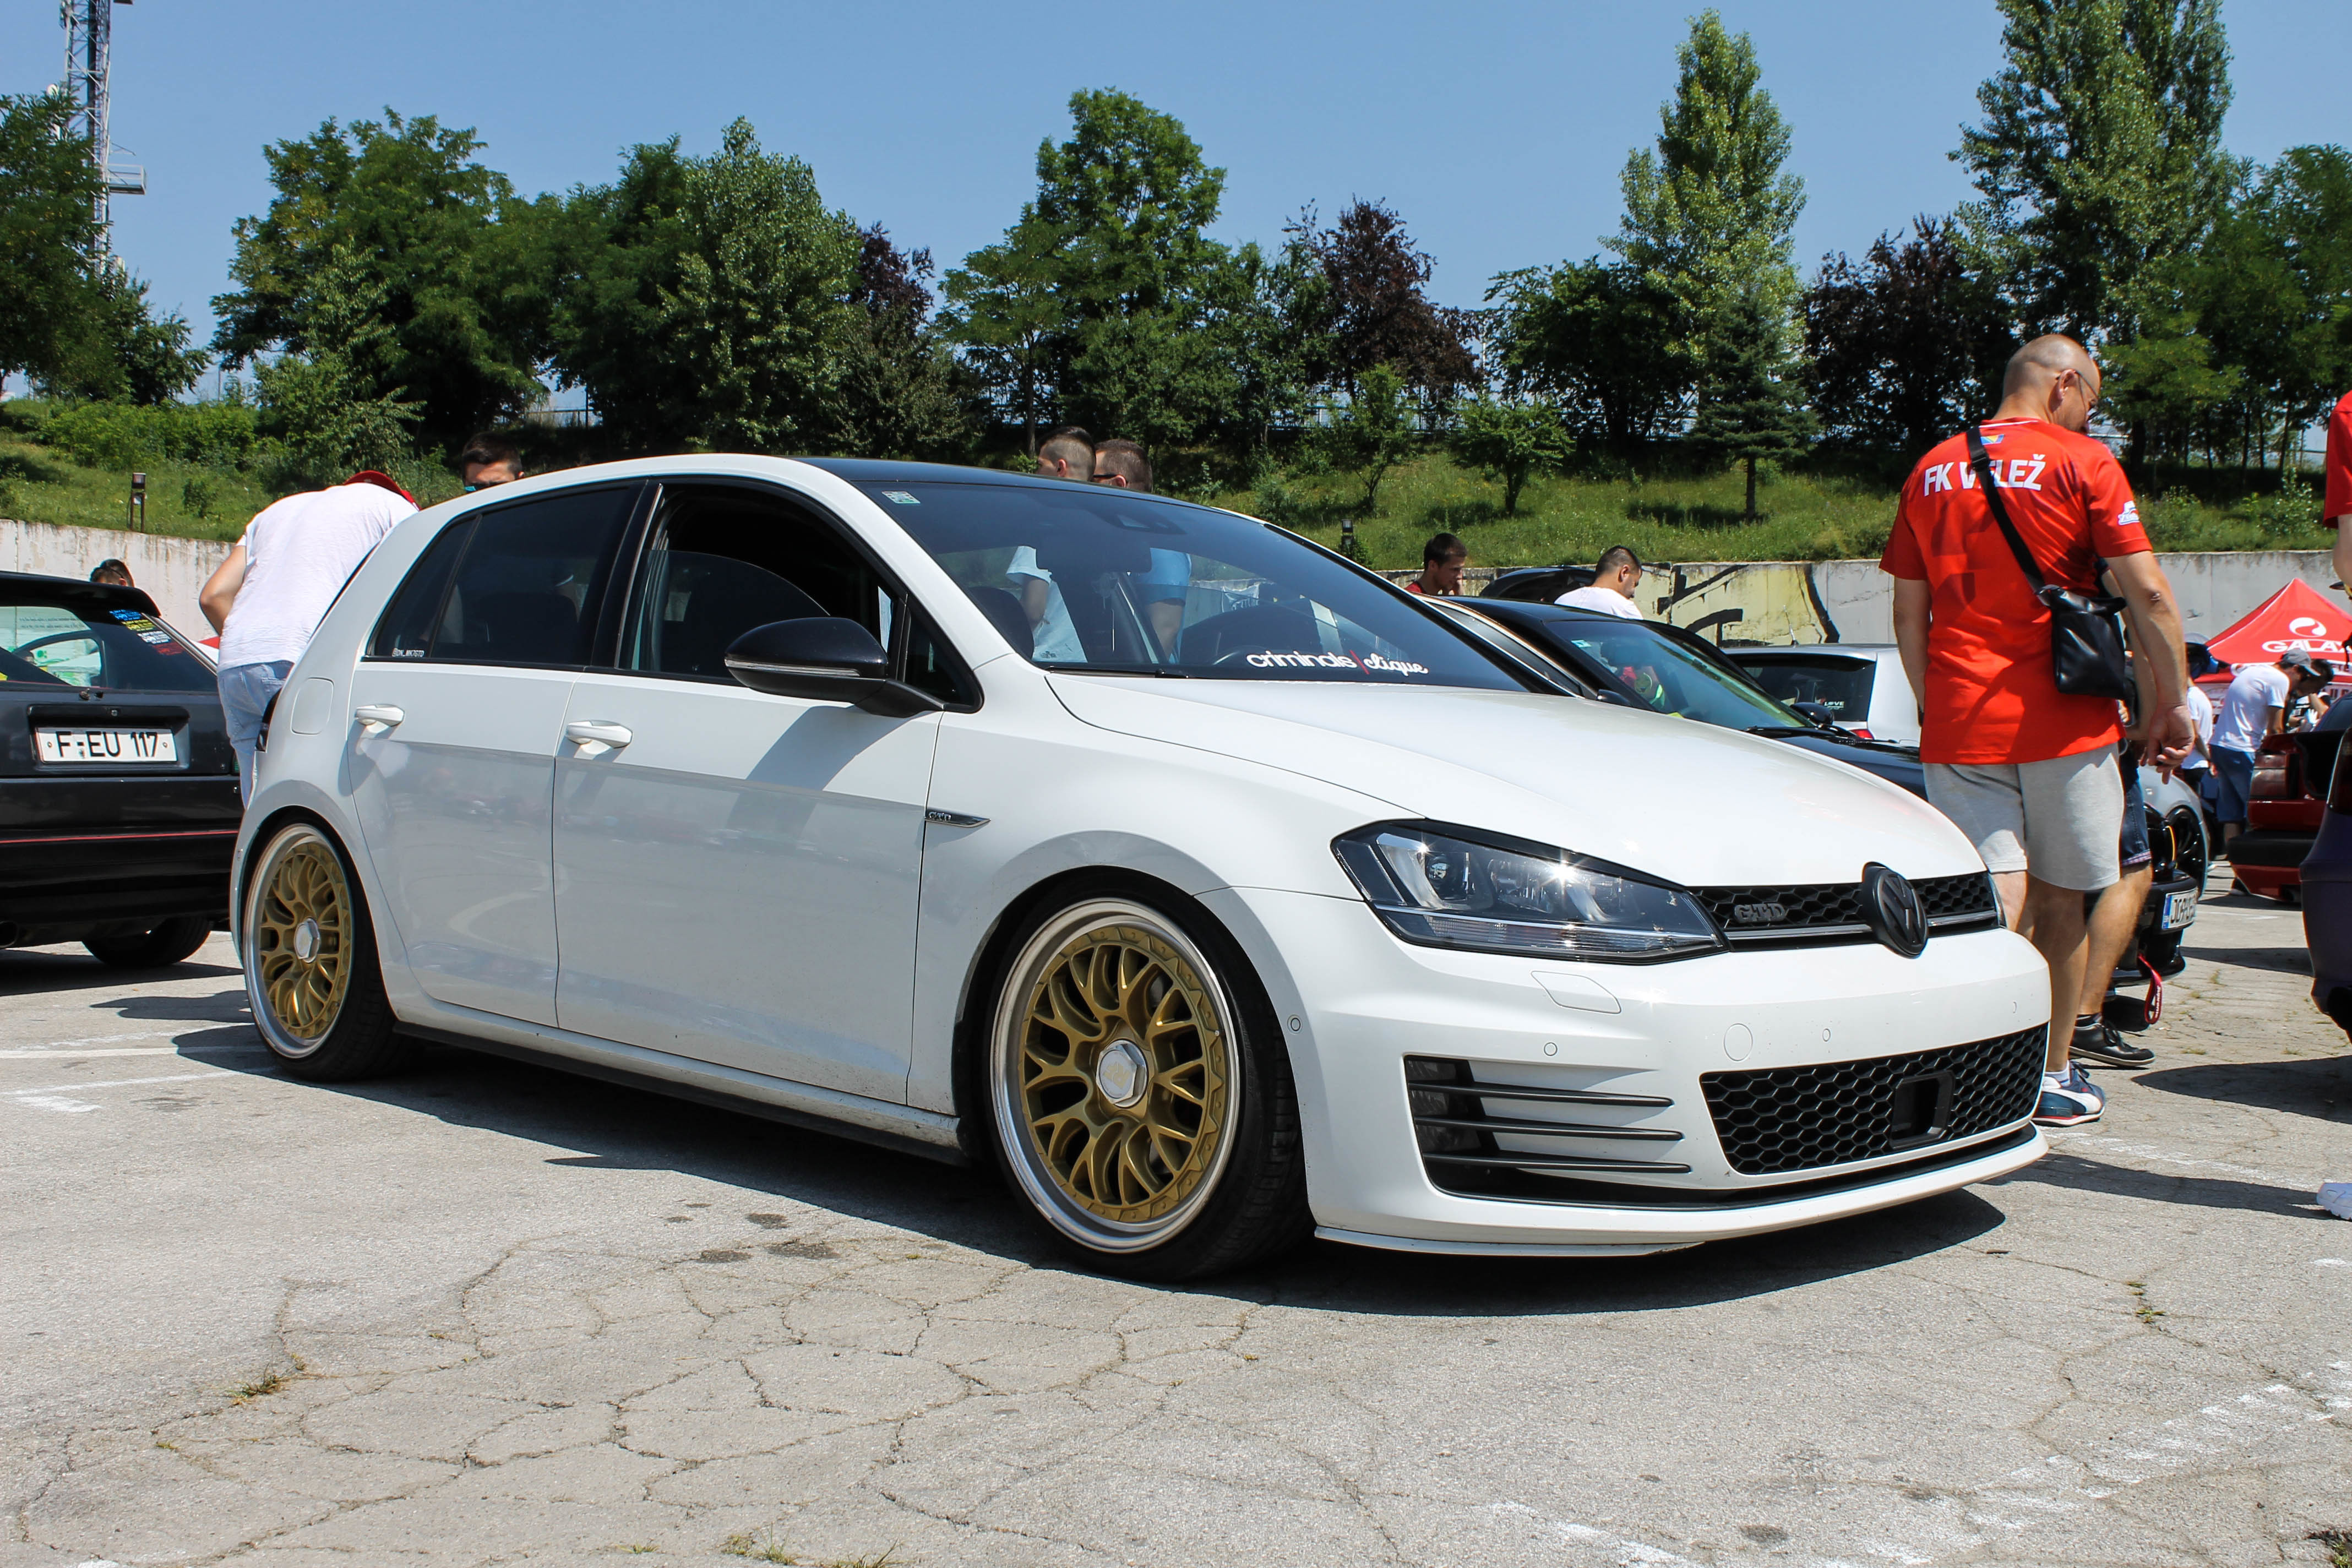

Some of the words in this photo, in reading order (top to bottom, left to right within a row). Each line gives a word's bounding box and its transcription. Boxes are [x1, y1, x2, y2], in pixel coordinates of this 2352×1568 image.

[1924, 462, 1954, 497] FK
[1959, 454, 2046, 491] VLEŽ
[1246, 648, 1358, 668] criminals
[1363, 653, 1429, 677] clique
[130, 731, 158, 758] 117
[928, 811, 952, 821] GTD
[1734, 902, 1786, 924] GTD
